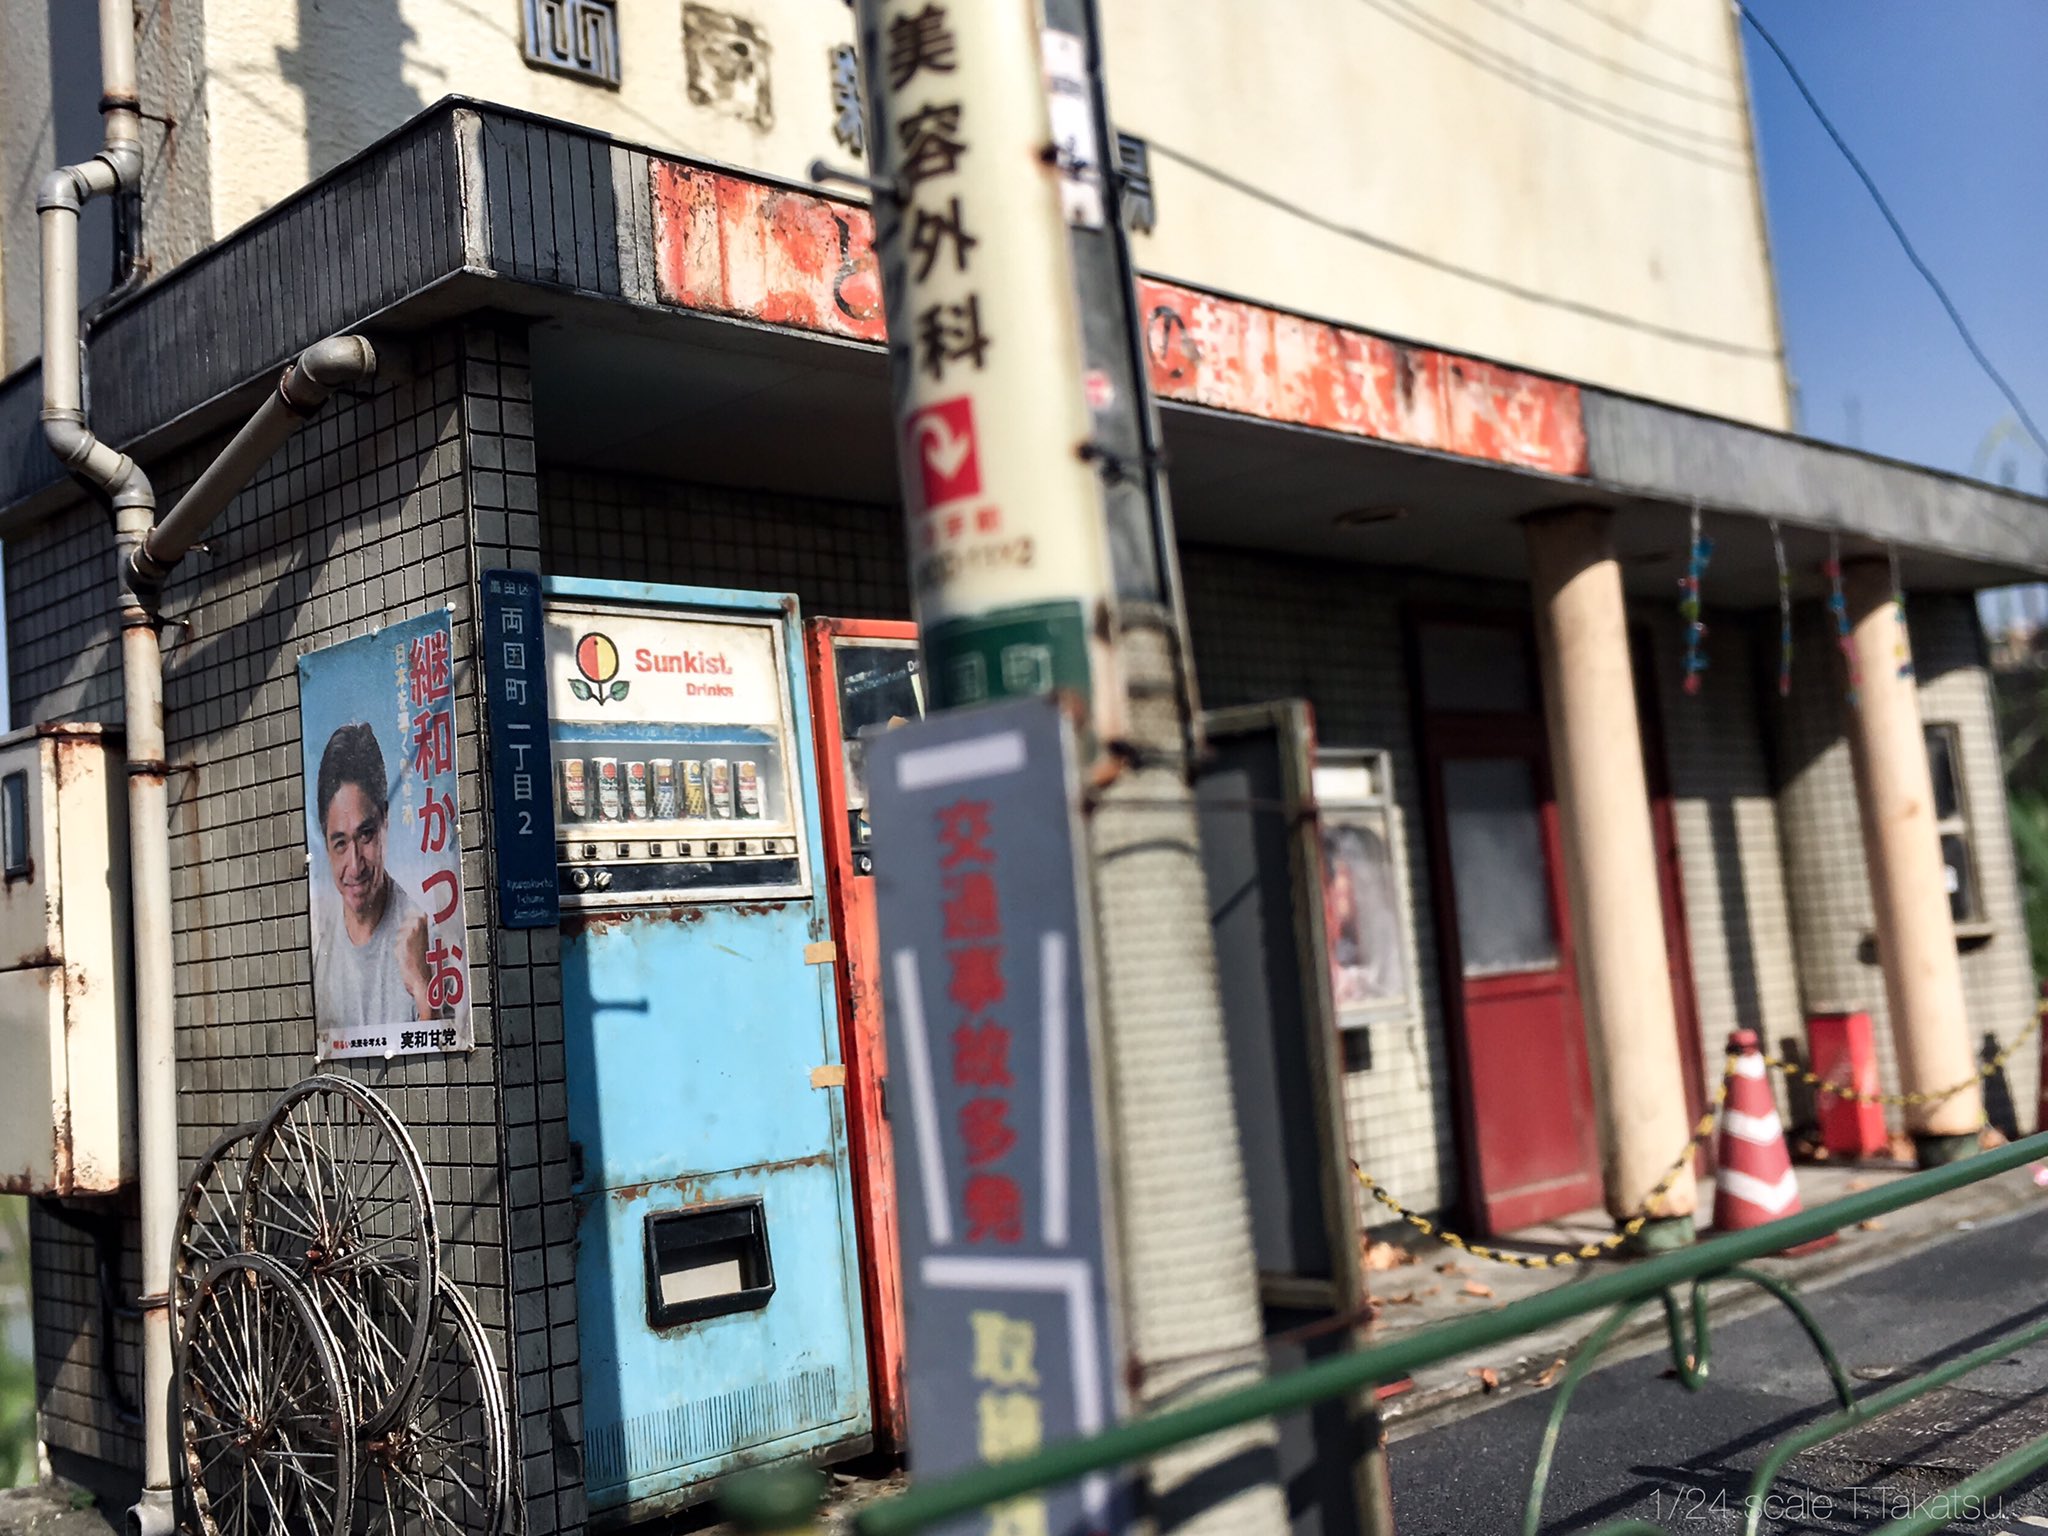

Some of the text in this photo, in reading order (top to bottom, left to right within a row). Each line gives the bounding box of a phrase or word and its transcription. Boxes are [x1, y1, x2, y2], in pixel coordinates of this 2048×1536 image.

[890, 3, 990, 379] 美容外科
[409, 630, 464, 1009] 継和かつお
[686, 683, 733, 697] Drinks
